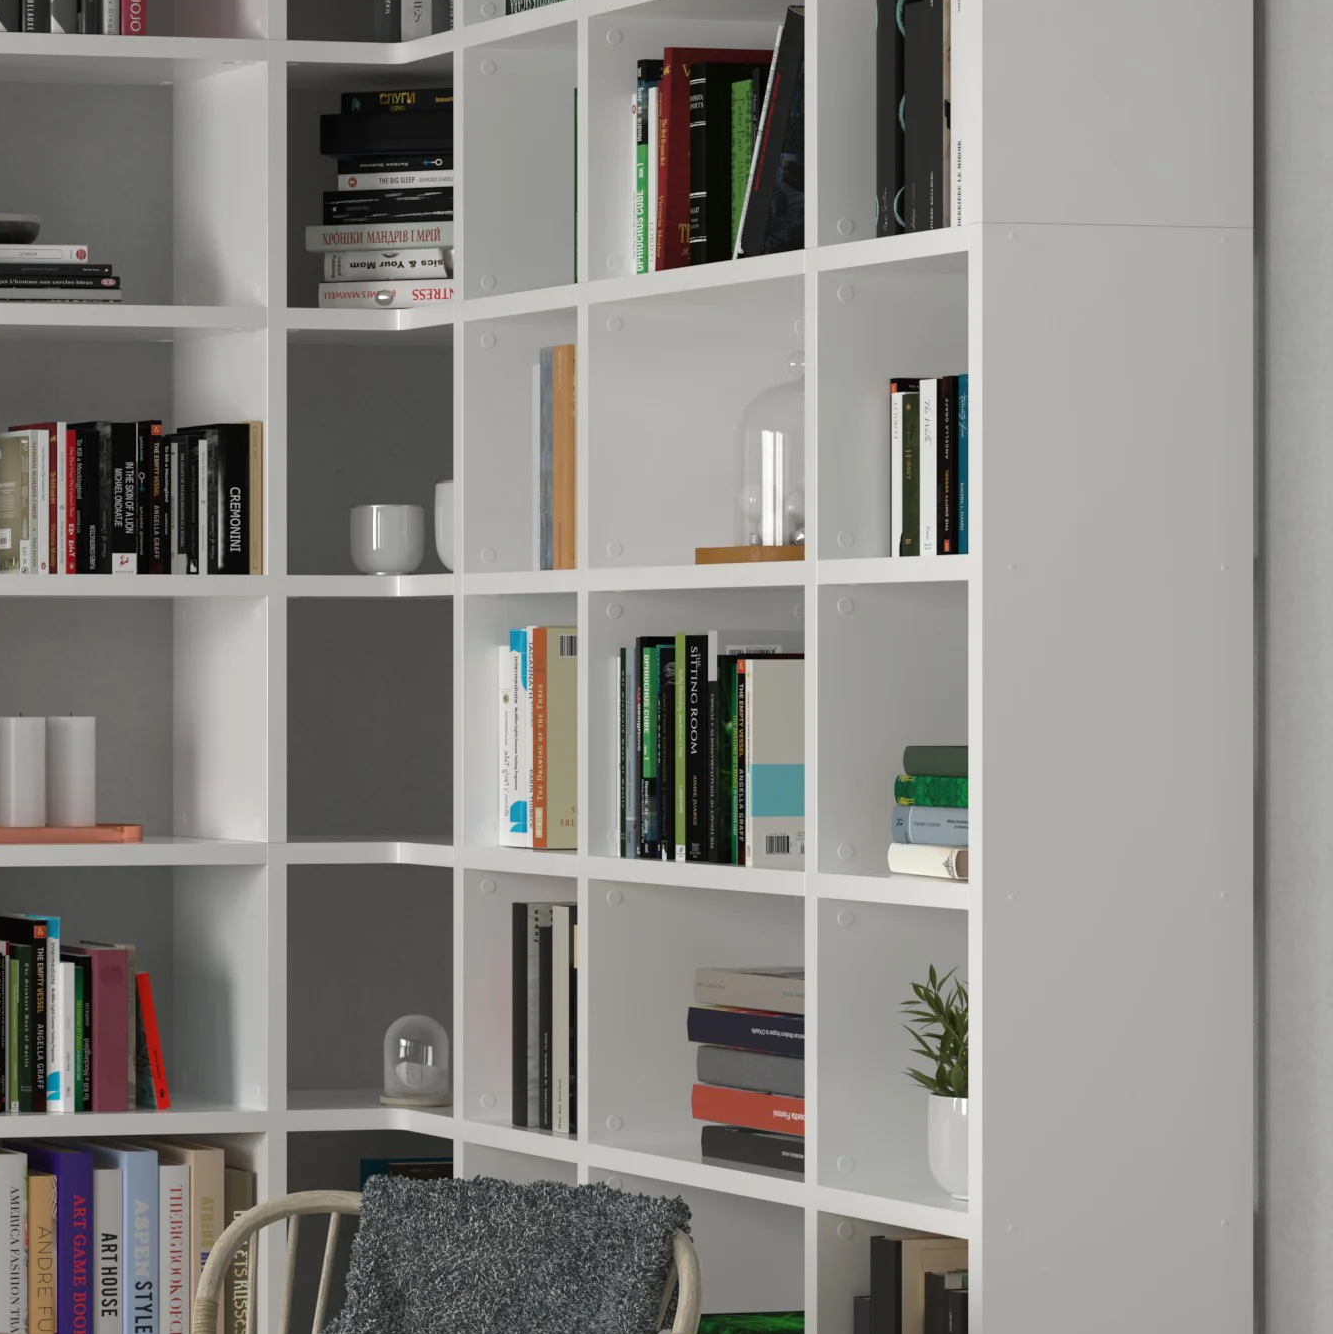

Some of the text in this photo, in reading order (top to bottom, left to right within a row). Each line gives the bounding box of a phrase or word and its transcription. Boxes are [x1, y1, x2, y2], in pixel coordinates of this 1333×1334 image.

[323, 290, 360, 300] MAXWELL
[114, 468, 122, 527] MICHAEL ONDAATJE
[124, 469, 134, 484] THE
[124, 485, 134, 501] SKIN
[124, 501, 134, 510] OF
[124, 518, 134, 533] LION
[230, 487, 241, 552] CREMONINI
[690, 645, 699, 755] SITTING ROOM
[10, 1186, 20, 1245] AMERICA
[73, 1194, 87, 1230] ART
[134, 1199, 151, 1278] ASPEN
[10, 1248, 20, 1305] FASHION
[37, 1226, 53, 1332] ANDRE FU
[73, 1234, 87, 1287] GAME
[101, 1232, 118, 1317] ART HOUSE
[135, 1280, 153, 1334] STYLE
